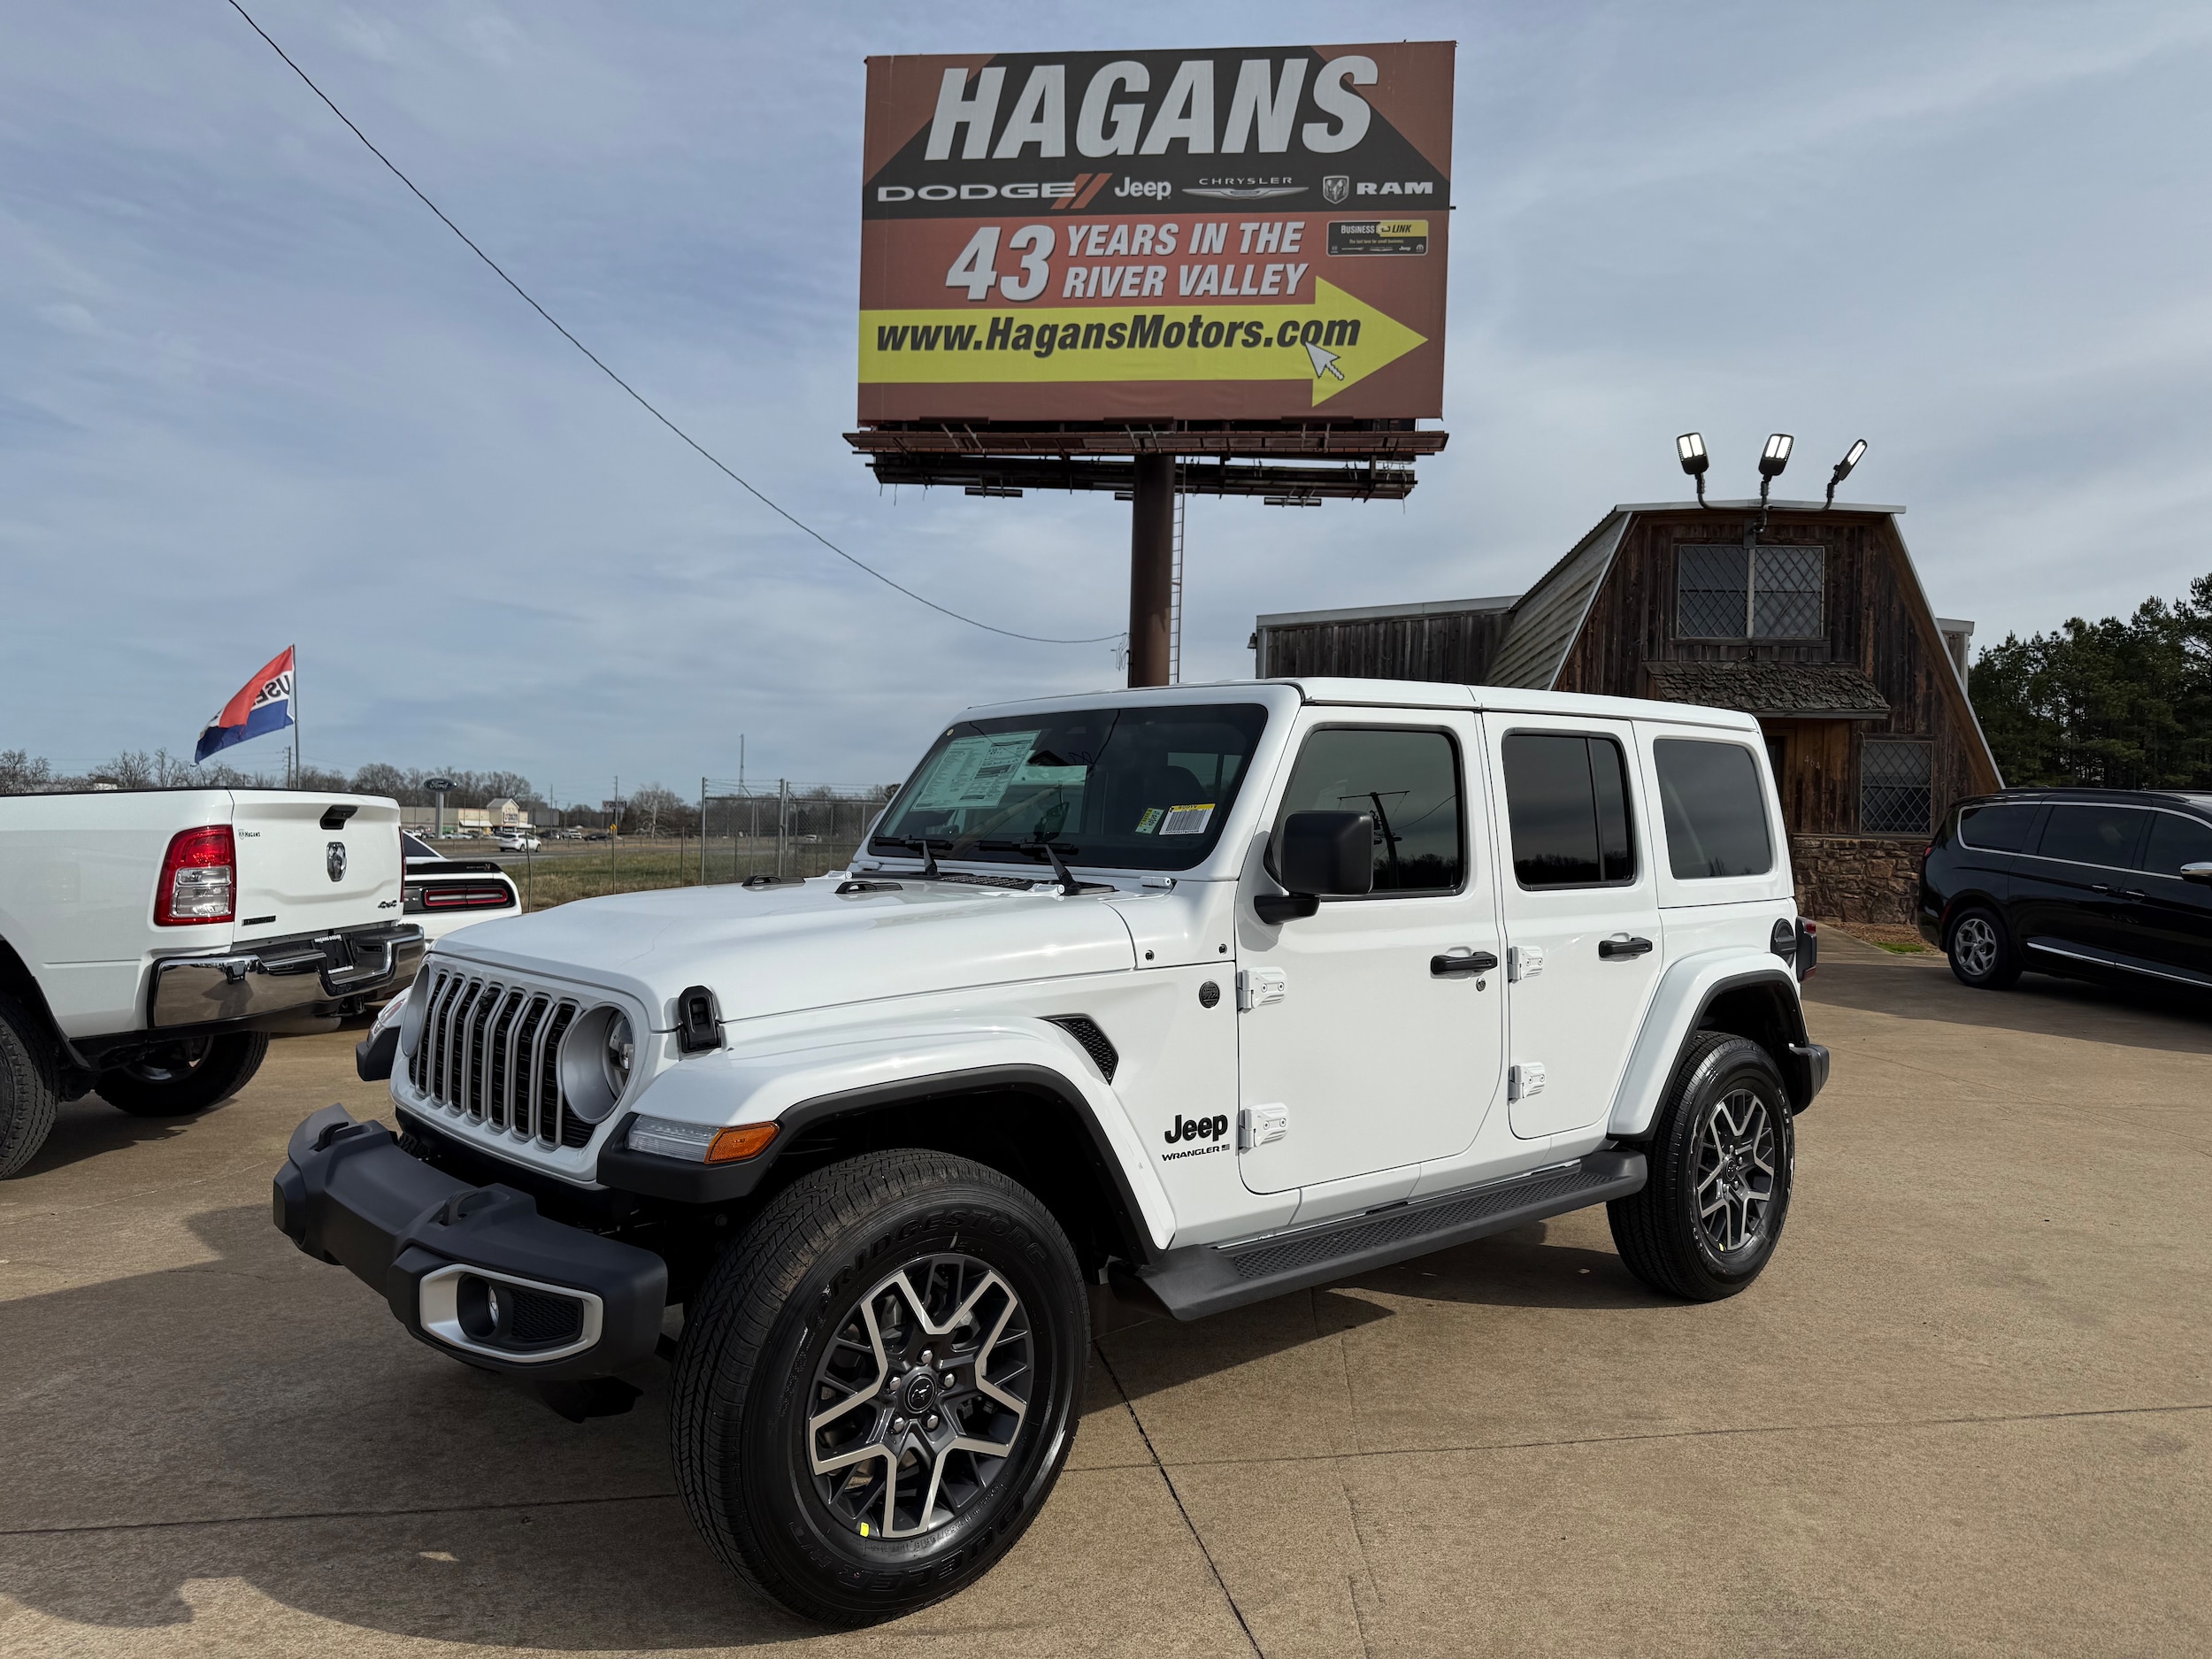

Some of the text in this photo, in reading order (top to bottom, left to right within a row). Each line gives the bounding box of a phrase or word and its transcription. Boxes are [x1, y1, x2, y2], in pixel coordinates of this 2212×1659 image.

[924, 55, 1379, 161] HAGANS
[878, 182, 1076, 202] DODGE
[1114, 176, 1172, 201] Jeep
[1198, 177, 1293, 186] CHRYSLER
[1356, 180, 1434, 195] RAM
[1067, 221, 1306, 256] YEARS IN THE
[1340, 225, 1375, 234] BUSINESS
[945, 225, 1056, 302] 43
[1063, 264, 1310, 298] RIVER VALLEY
[878, 314, 1362, 357] www.HagansMotors.com
[1164, 1114, 1228, 1144] Jeep
[1162, 1146, 1220, 1161] WRANGLER
[836, 1493, 1026, 1593] DUELER
